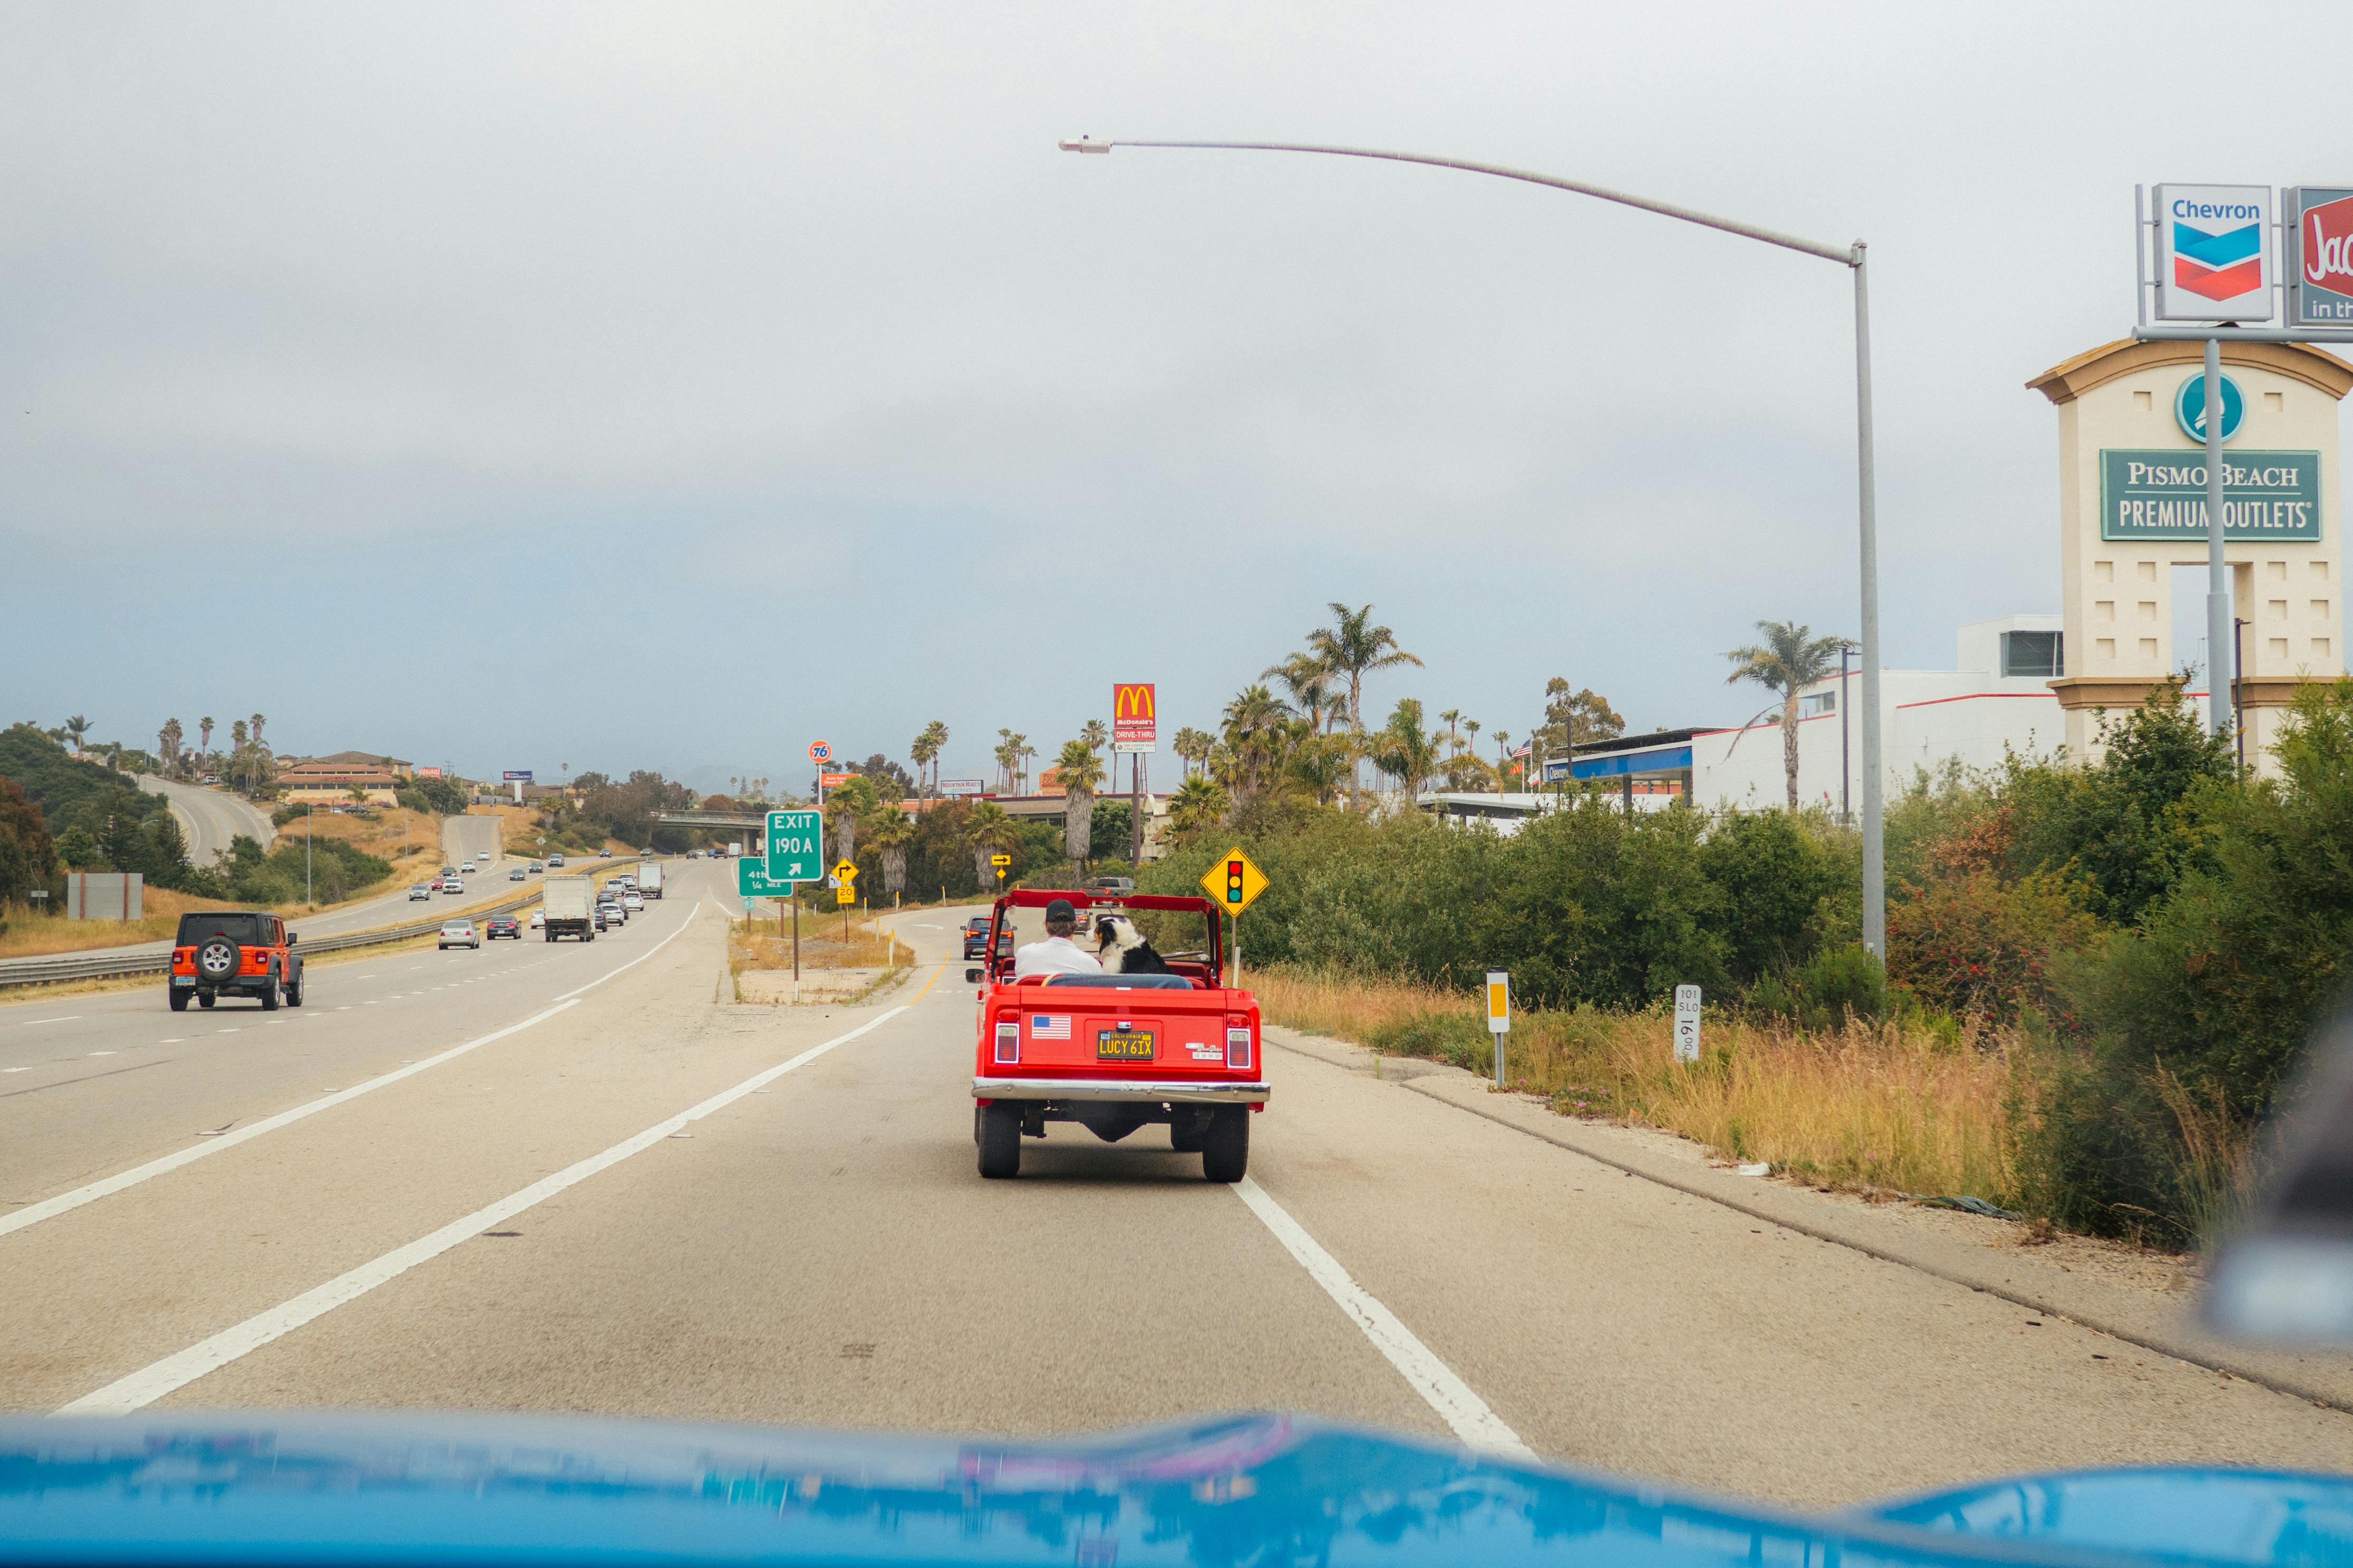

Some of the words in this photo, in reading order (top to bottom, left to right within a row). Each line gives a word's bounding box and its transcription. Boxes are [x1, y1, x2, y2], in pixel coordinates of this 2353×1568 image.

[2172, 199, 2260, 219] Chevron
[2312, 300, 2331, 317] in
[2127, 462, 2208, 486] PISMO
[2221, 463, 2299, 486] BEACH
[812, 745, 828, 758] 76
[774, 814, 813, 829] EXIT
[1681, 989, 1696, 999] 101
[1679, 1002, 1698, 1012] SLO
[1099, 1040, 1128, 1054] LUCY
[1130, 1040, 1151, 1055] 6IX
